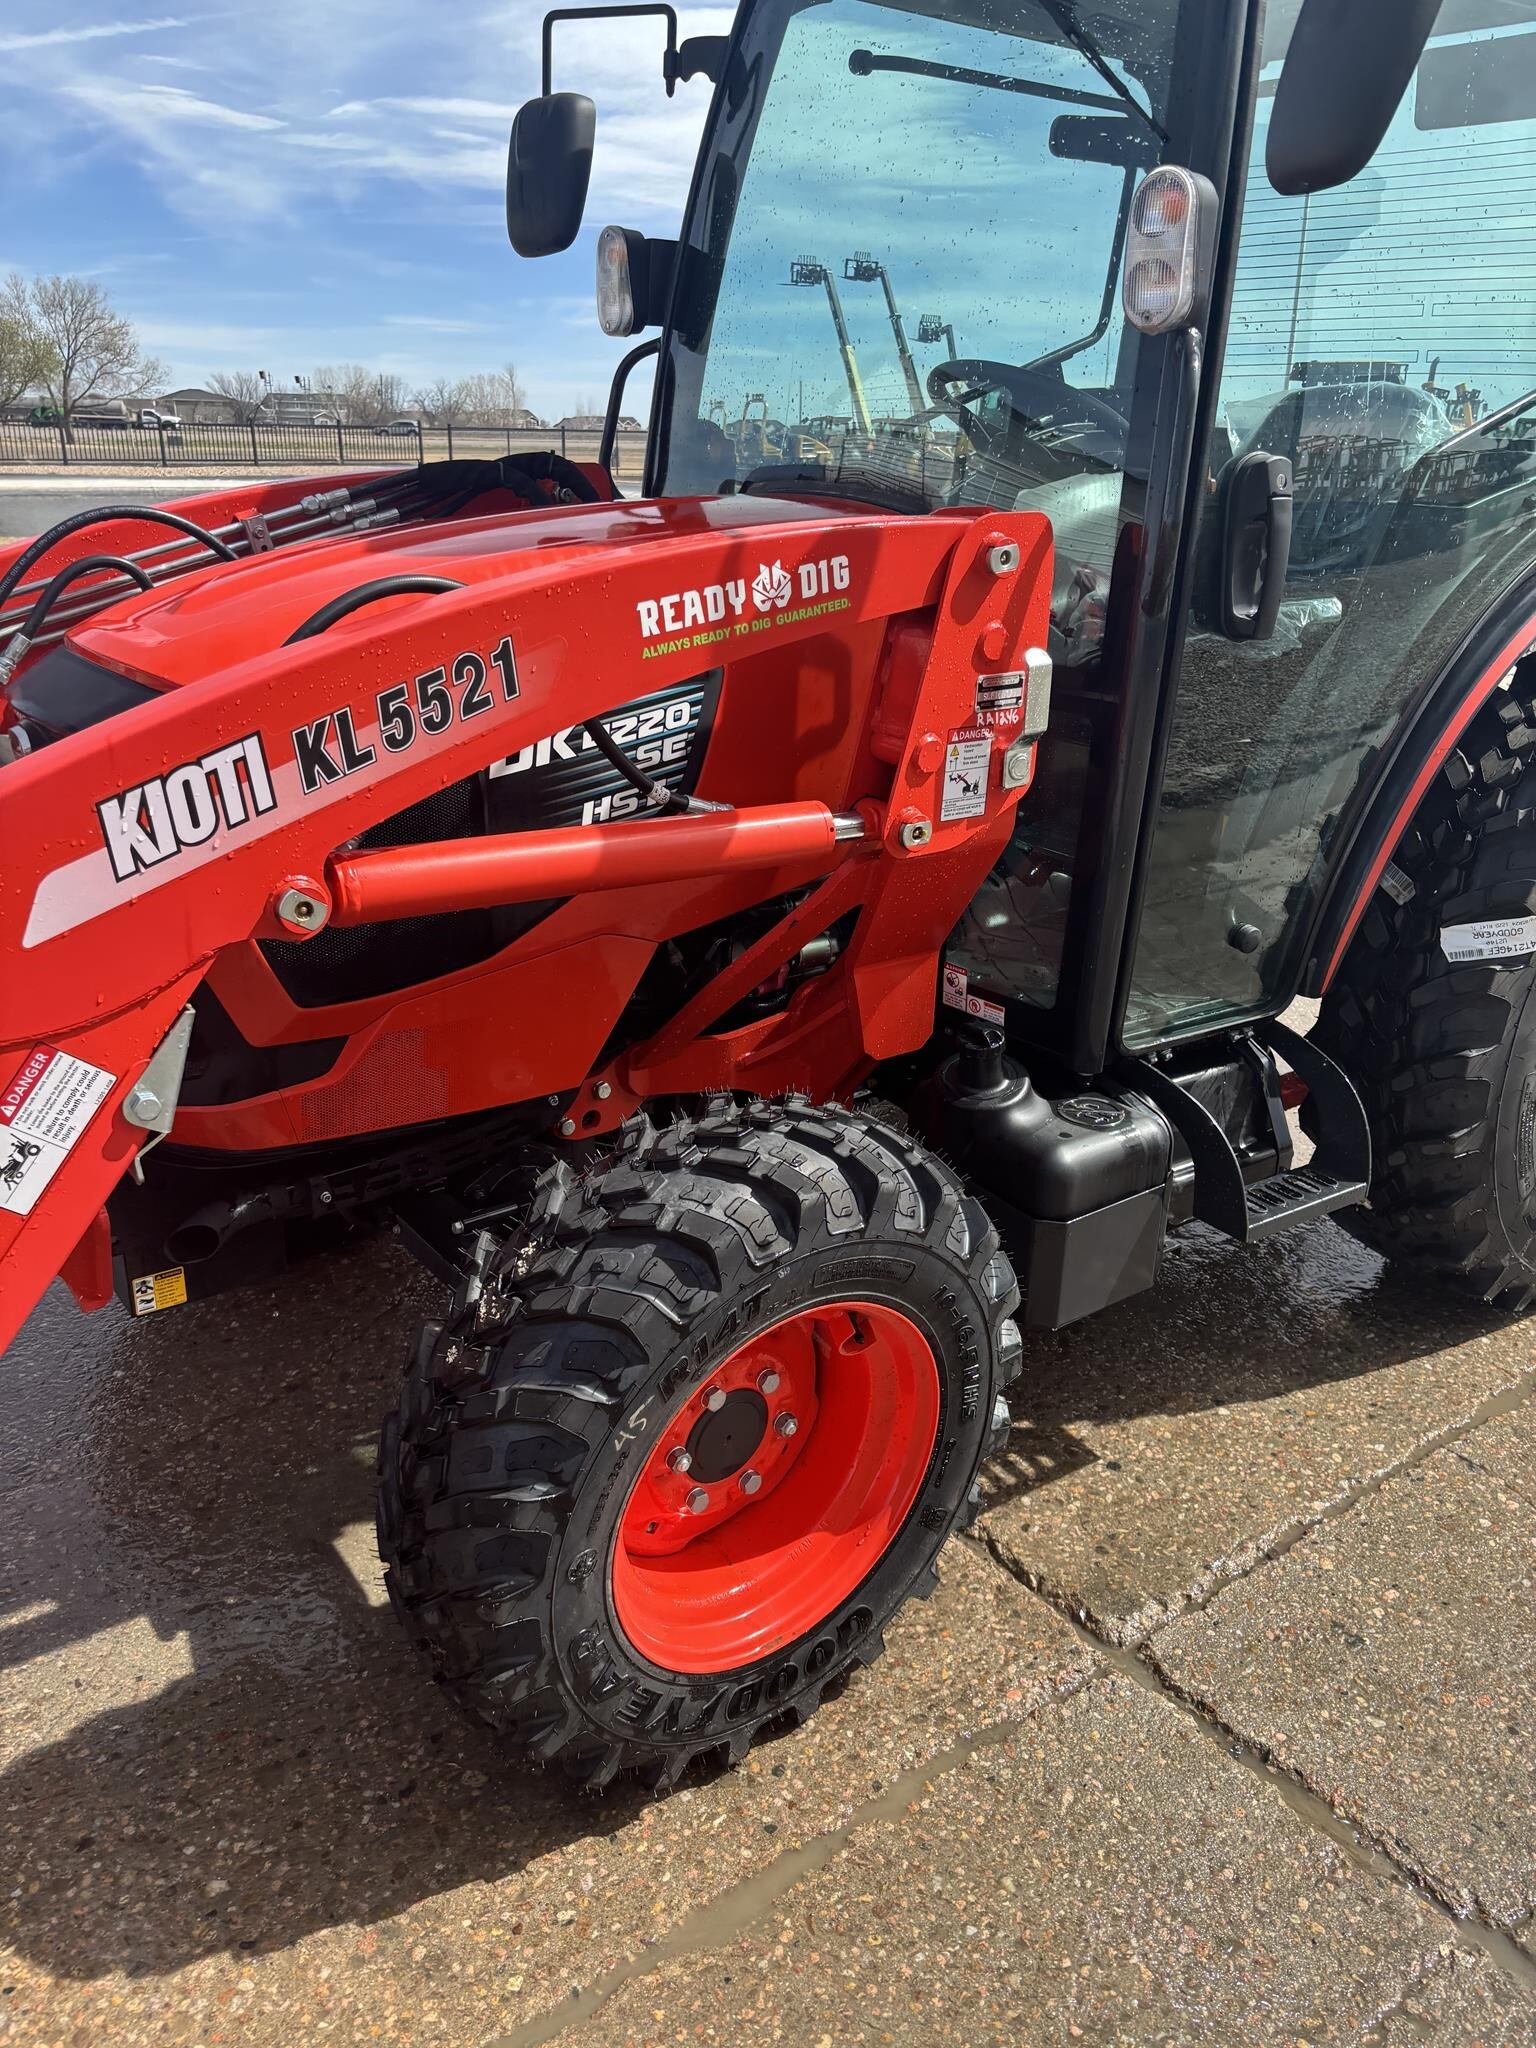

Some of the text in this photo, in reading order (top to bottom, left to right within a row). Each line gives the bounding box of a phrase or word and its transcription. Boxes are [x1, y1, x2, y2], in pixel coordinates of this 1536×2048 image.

[636, 555, 850, 638] READY DIG
[642, 598, 852, 659] ALWAYS READY TO DIG GUARANTEED.
[633, 732, 690, 769] SE
[960, 728, 991, 740] DANGER
[96, 731, 278, 883] KIOTI
[1472, 927, 1524, 940] GOODYEAR
[7, 1053, 49, 1104] DANGER
[43, 1069, 90, 1136] Failure to comply could
[53, 1122, 66, 1139] result
[62, 1116, 70, 1124] in
[68, 1099, 82, 1115] death
[85, 1070, 101, 1091] serious
[59, 1125, 76, 1142] injury.
[567, 1604, 874, 1736] GOODYEAR
